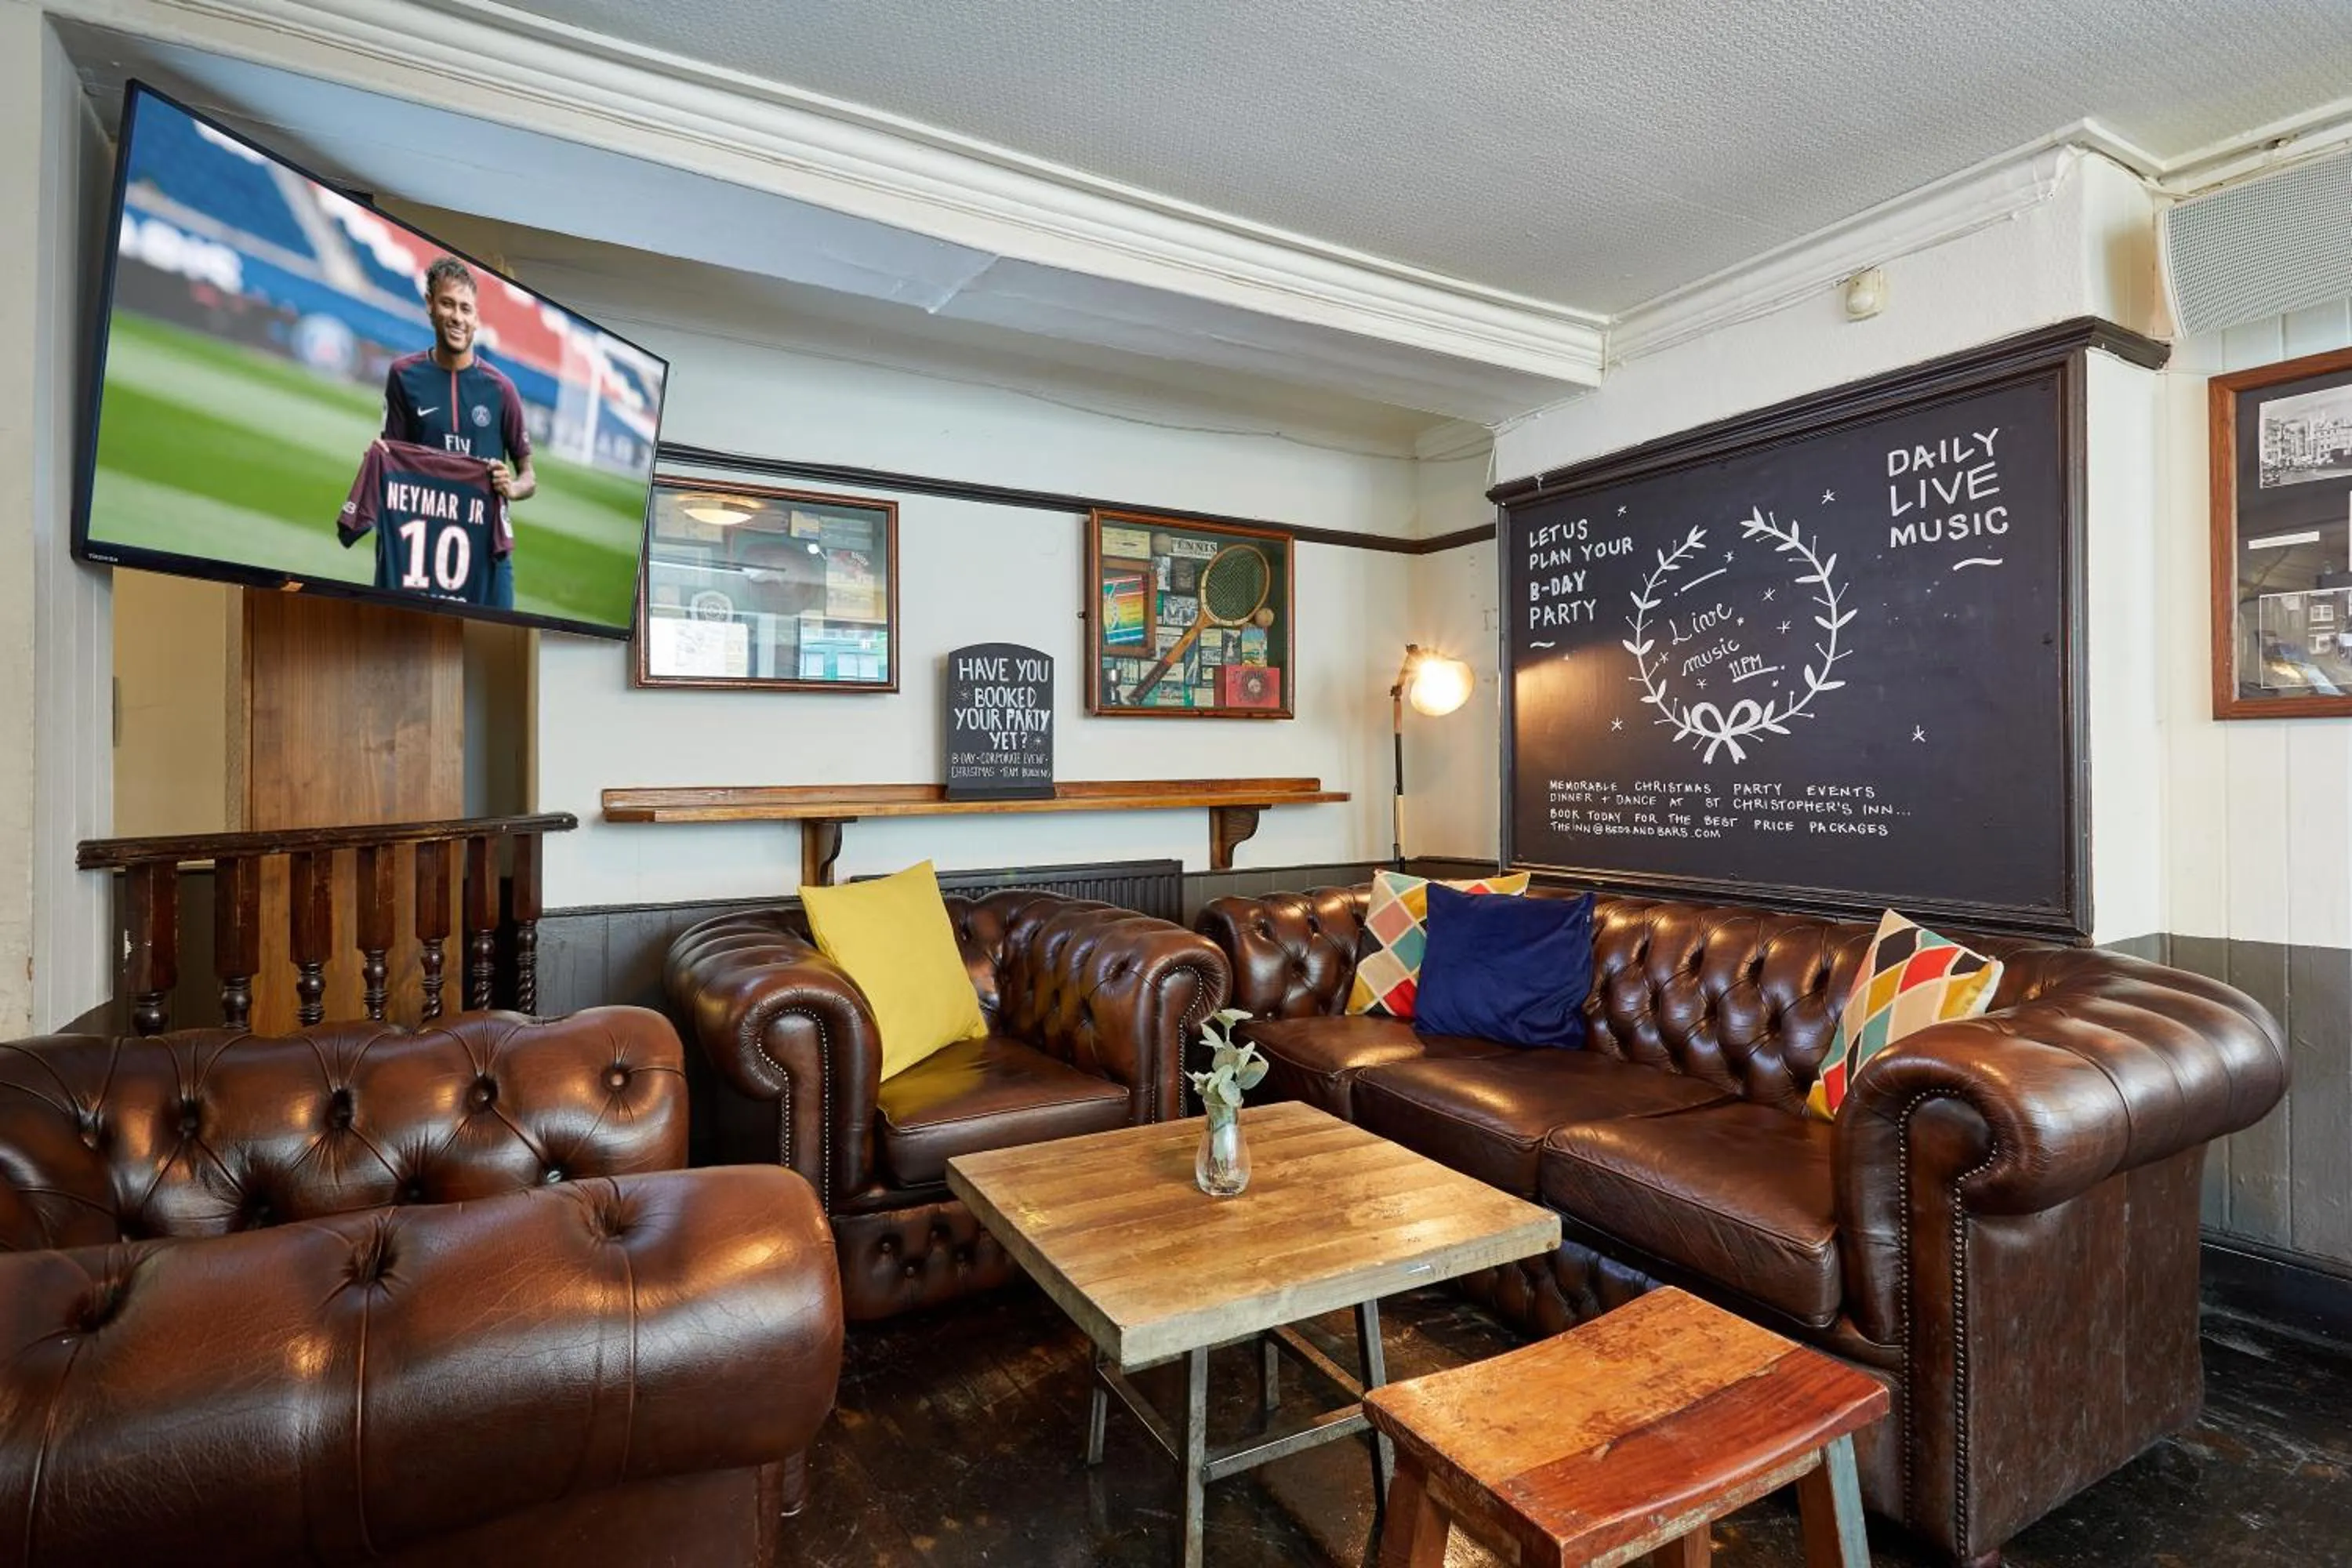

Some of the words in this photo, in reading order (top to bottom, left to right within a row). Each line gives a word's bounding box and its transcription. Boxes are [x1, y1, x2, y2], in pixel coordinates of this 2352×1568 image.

[1887, 427, 1998, 477] DAILY
[387, 482, 459, 521] NEYMAR
[468, 499, 484, 524] JR
[1890, 461, 1999, 517] LIVE
[1890, 506, 2009, 548] MUSIC
[399, 519, 470, 591] 10
[1530, 547, 1571, 570] PLAN
[1581, 536, 1633, 562] YOUR
[1530, 569, 1586, 601] B-DAY
[1530, 598, 1597, 630] PARTY
[1669, 603, 1732, 645] Live
[958, 657, 1009, 681] HAVE
[1016, 659, 1049, 682] YOU
[1682, 637, 1740, 677] music
[1728, 653, 1763, 678] 11PM
[974, 686, 1036, 708] BOOKED
[954, 708, 1003, 730] YOUR
[1006, 709, 1051, 731] PARTY
[989, 731, 1028, 750] YET?
[1549, 780, 1617, 792] MEMORABLE
[1635, 780, 1711, 794] CHRISTMAS
[1733, 783, 1782, 796] PARTY
[1806, 786, 1875, 799] EVENTS
[1550, 793, 1592, 803] DINNER
[1616, 794, 1657, 806] DANCE
[1669, 797, 1684, 808] AT
[1705, 797, 1721, 808] ST
[1733, 798, 1853, 815] CHRISTOPHER'S
[1550, 808, 1581, 819] BOOK
[1587, 810, 1622, 823] TODAY
[1635, 813, 1658, 824] FOR
[1668, 813, 1692, 825] THE
[1704, 815, 1738, 827] BEST
[1754, 819, 1795, 831] PRICE
[1809, 821, 1889, 837] PACKAGES
